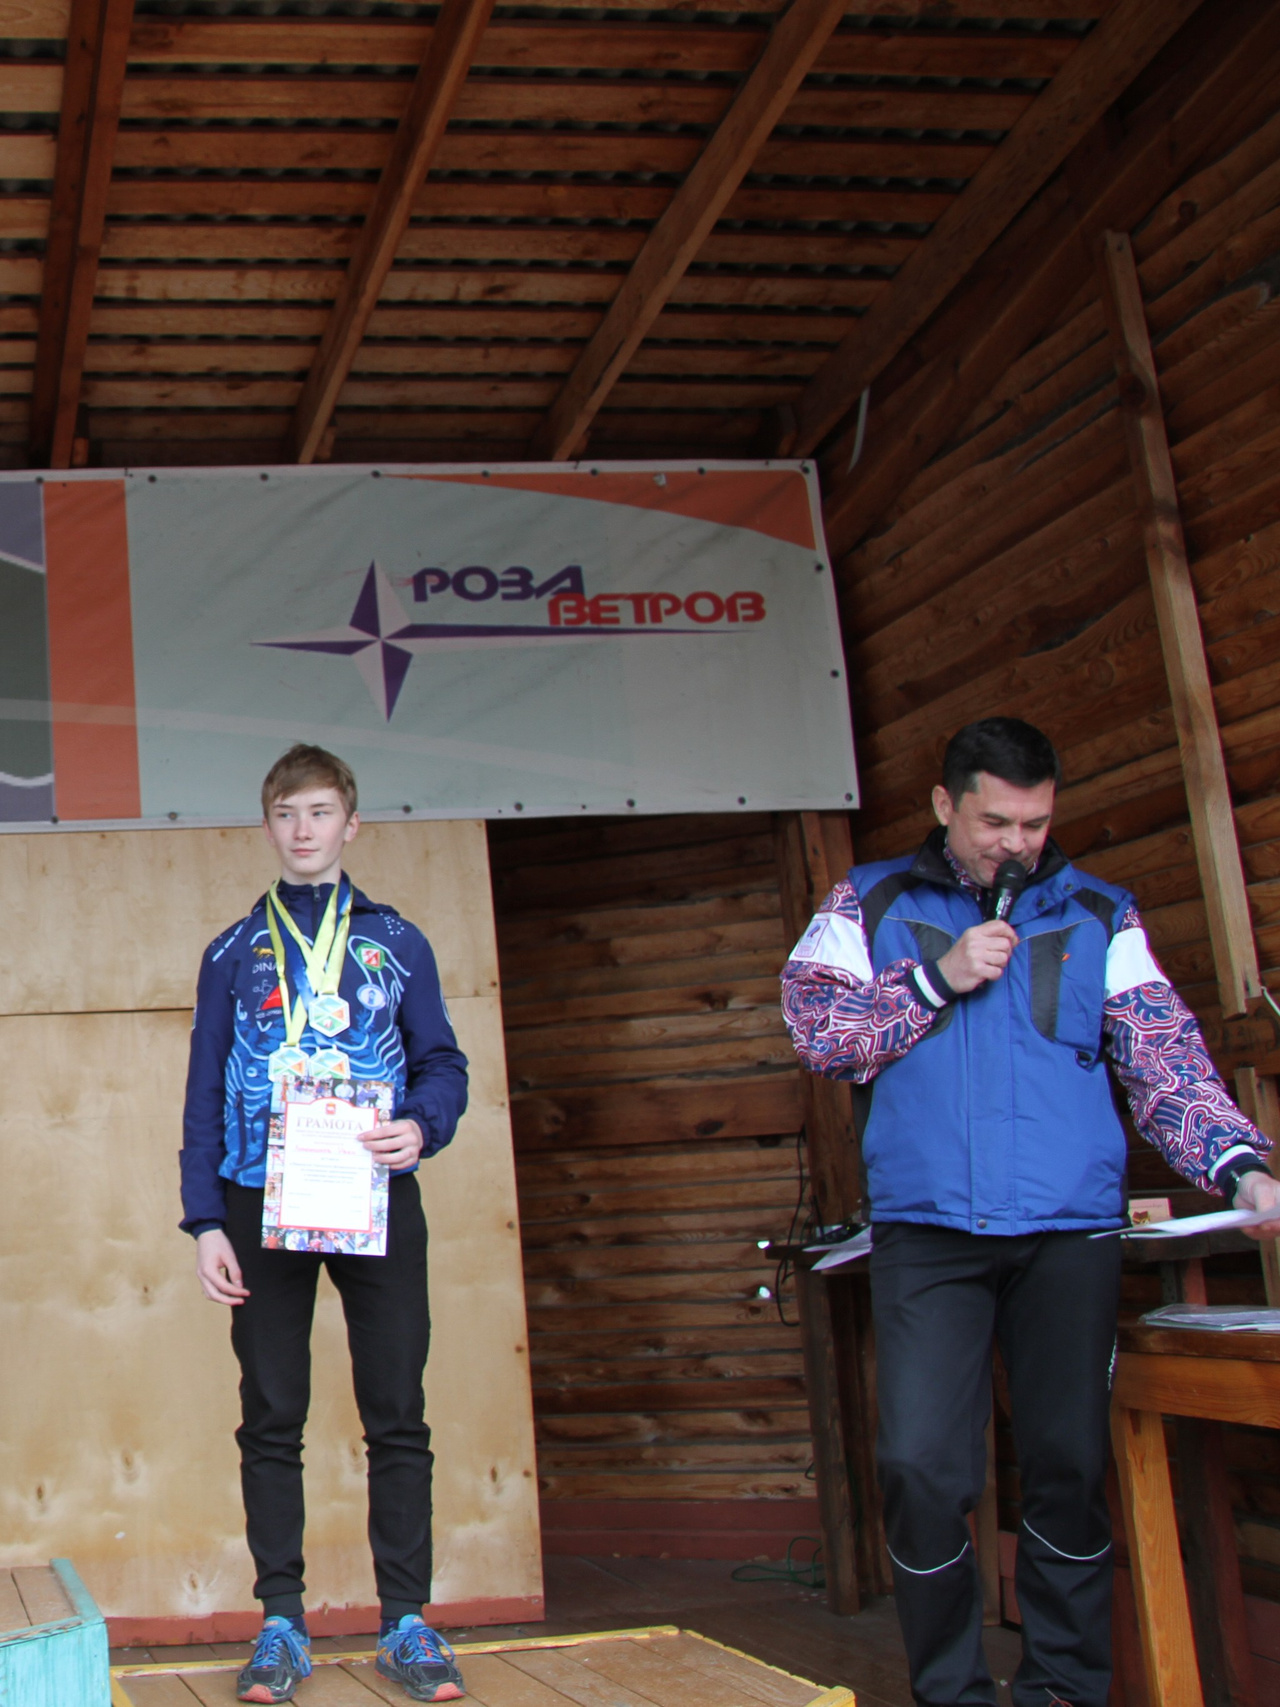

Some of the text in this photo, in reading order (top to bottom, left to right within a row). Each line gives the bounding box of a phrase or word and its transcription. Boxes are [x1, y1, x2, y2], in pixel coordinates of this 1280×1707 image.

[412, 565, 586, 602] РОЗА
[548, 591, 766, 626] ВЕТРОВ
[296, 1116, 364, 1131] ГРАМОТА
